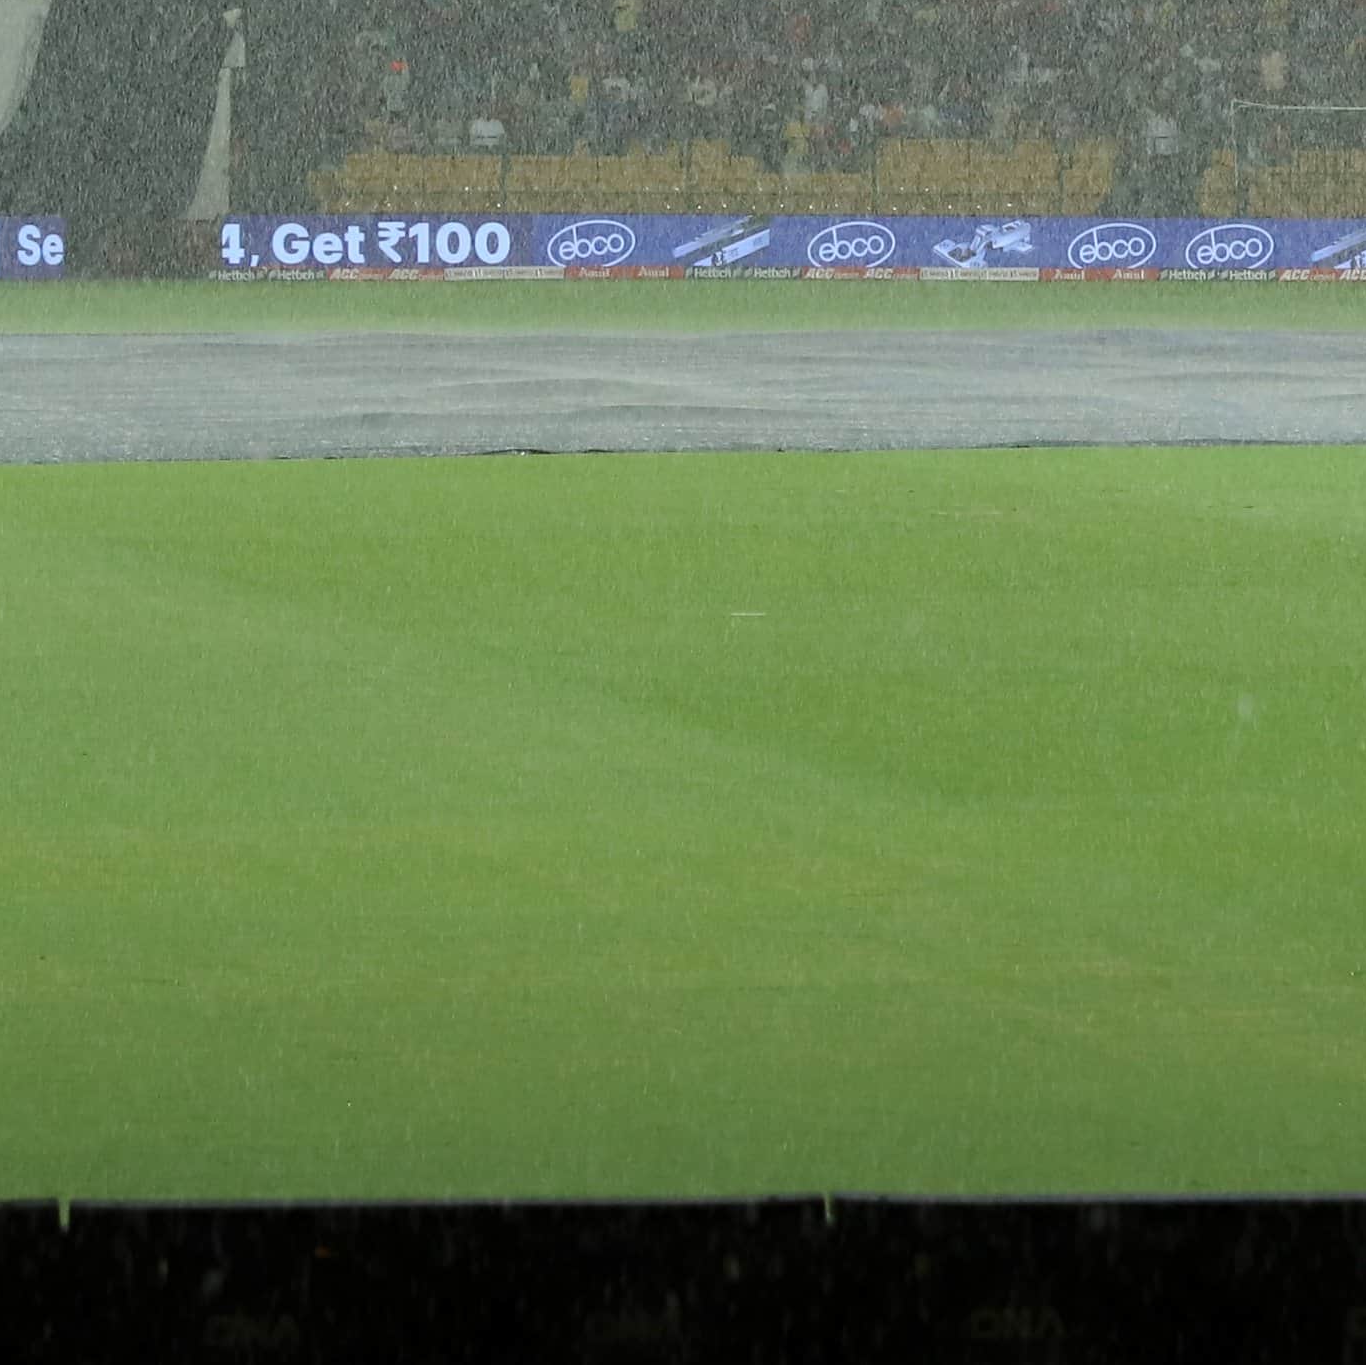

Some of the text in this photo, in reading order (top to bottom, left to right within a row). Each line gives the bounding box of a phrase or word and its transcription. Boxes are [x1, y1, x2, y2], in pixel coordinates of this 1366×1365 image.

[271, 222, 365, 264] Get
[377, 221, 511, 264] ₹100
[559, 222, 624, 261] ebco
[819, 223, 883, 261] ebco
[1079, 223, 1146, 261] ebco
[1197, 225, 1262, 264] ebco
[330, 269, 359, 280] ACC
[388, 269, 419, 280] ACC
[805, 268, 833, 279] ACC
[863, 268, 892, 279] ACC
[1280, 270, 1310, 280] ACC
